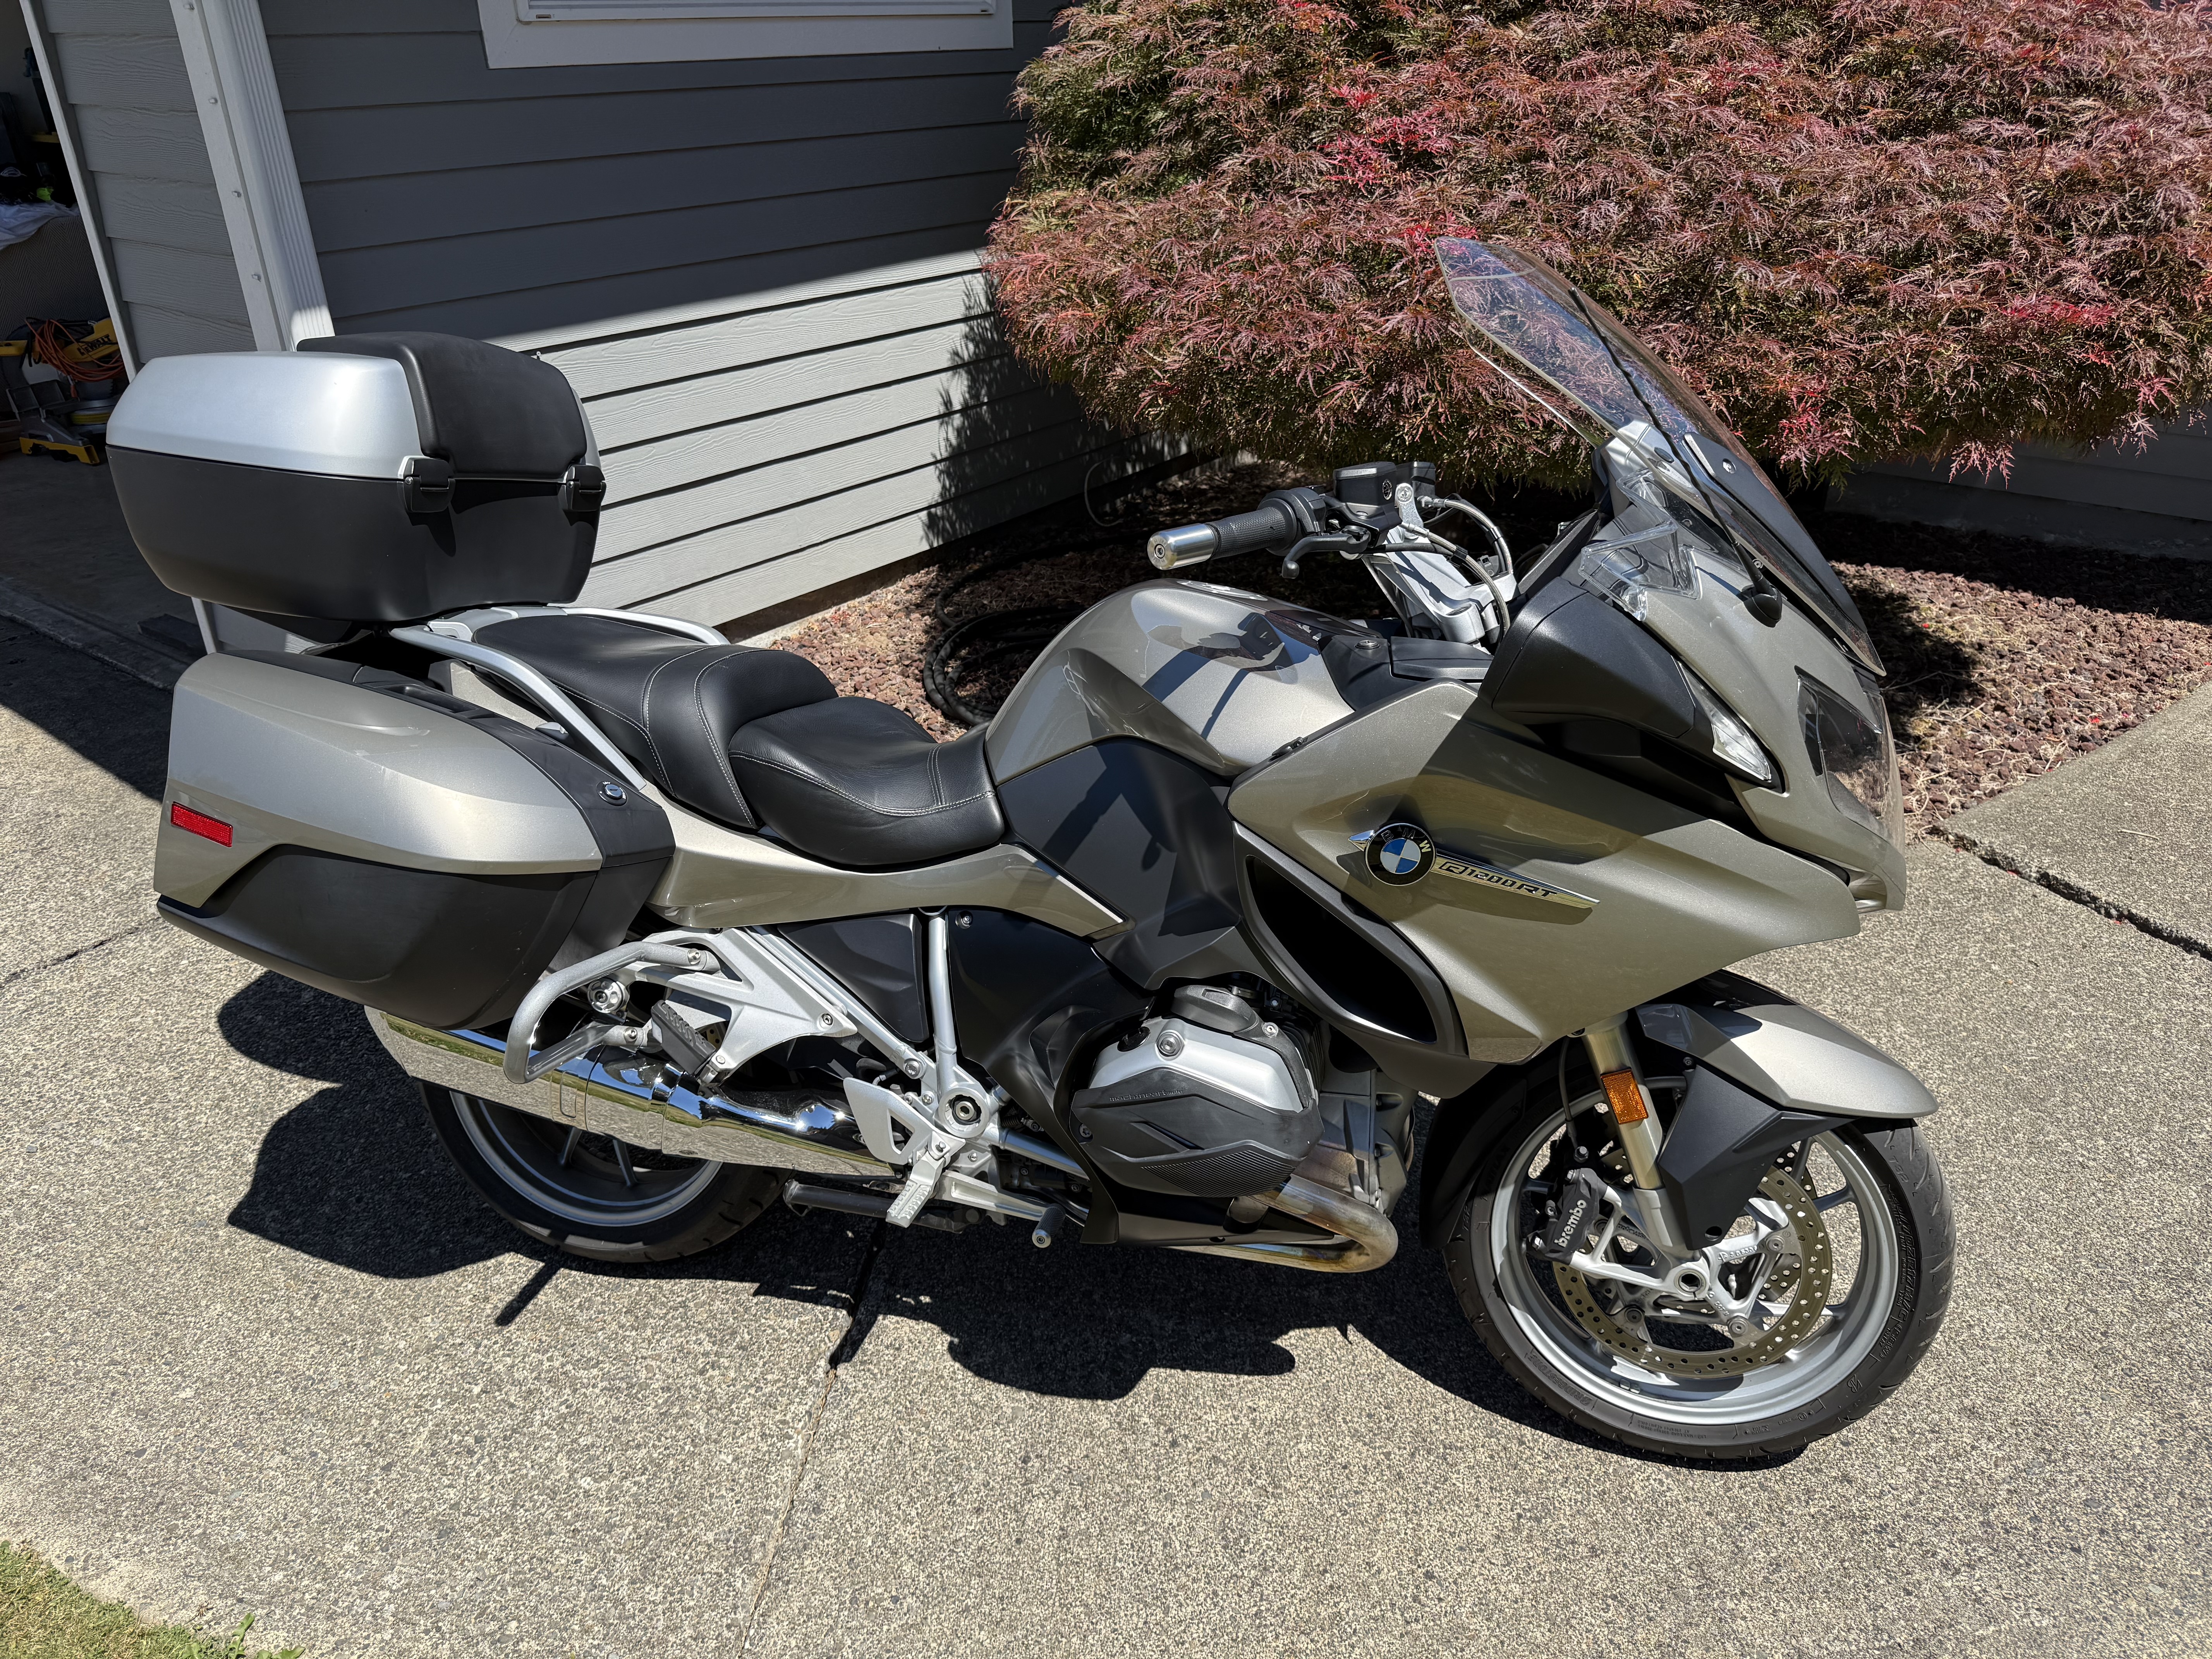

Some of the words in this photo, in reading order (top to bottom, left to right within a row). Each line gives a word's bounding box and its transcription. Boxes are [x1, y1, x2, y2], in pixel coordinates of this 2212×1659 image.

[1381, 828, 1431, 852] BMW
[1554, 1200, 1587, 1248] brembo
[1527, 1350, 1593, 1407] BRIDGESTONE
